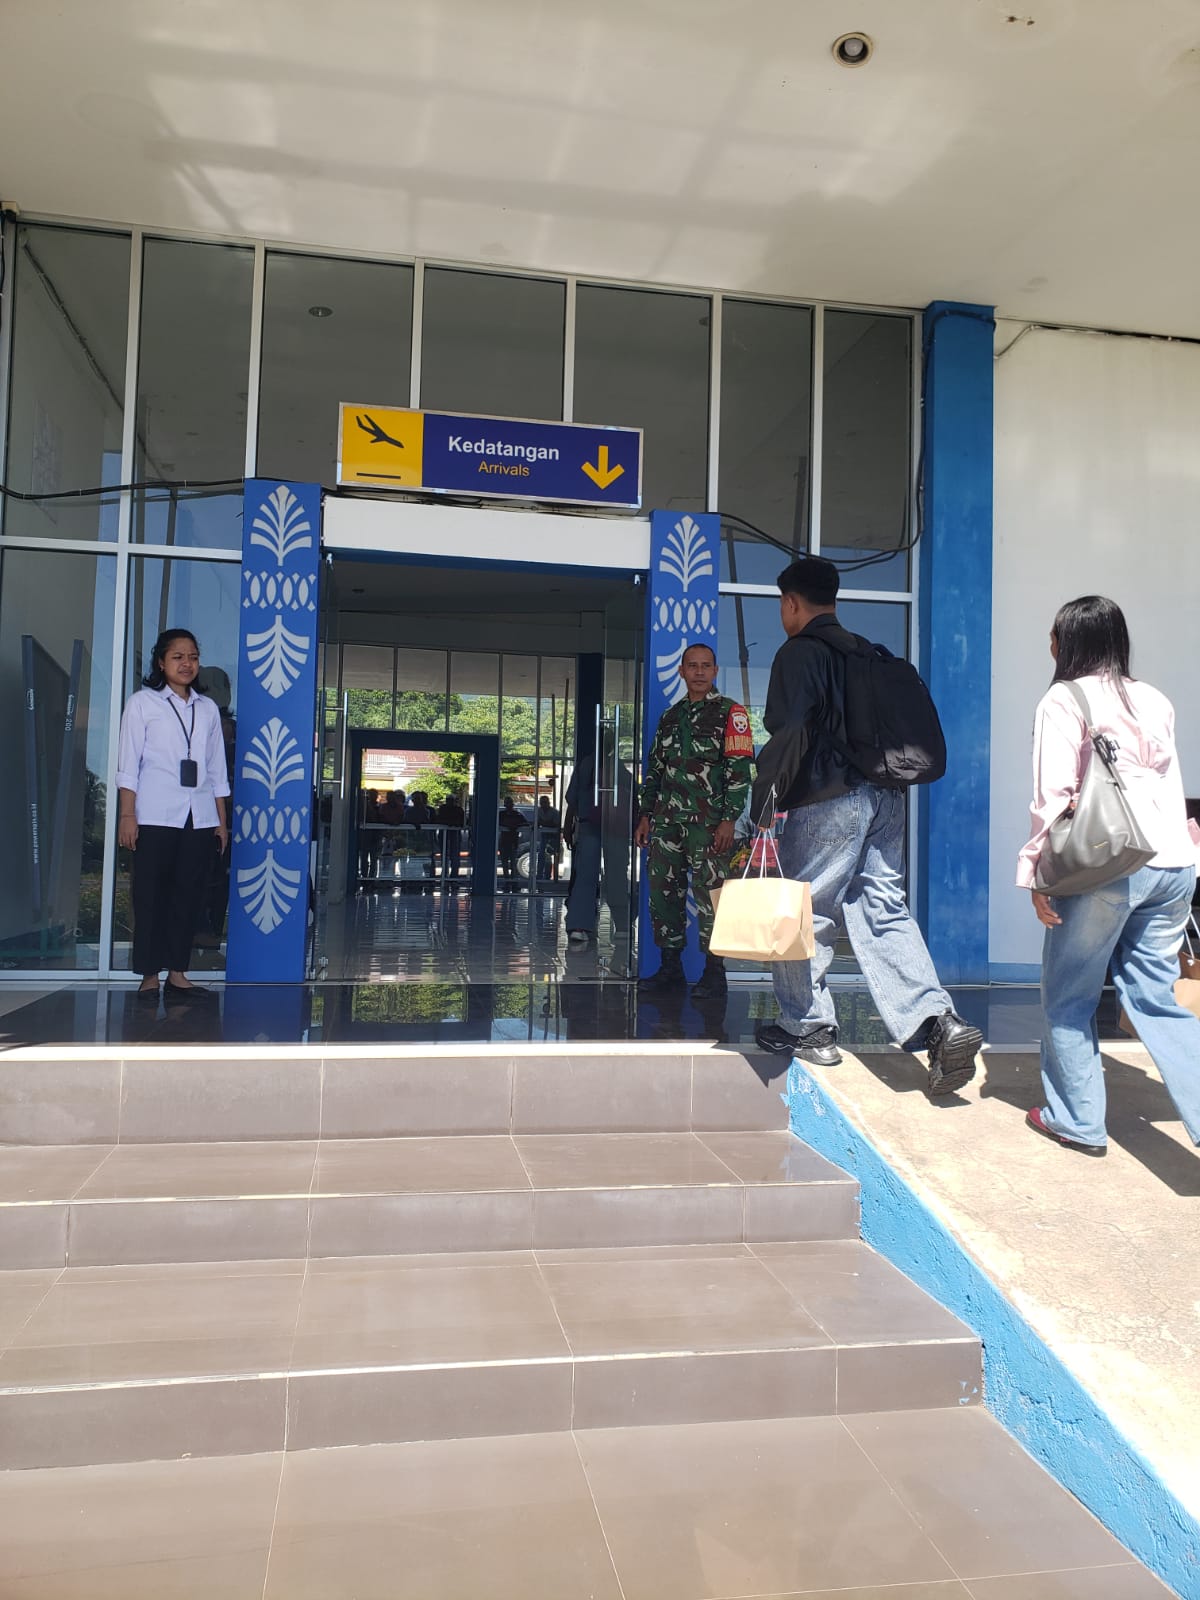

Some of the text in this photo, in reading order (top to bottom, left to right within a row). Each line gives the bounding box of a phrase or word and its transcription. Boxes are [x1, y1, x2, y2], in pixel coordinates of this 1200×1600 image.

[448, 436, 559, 462] Kedatangan
[479, 461, 530, 477] Arrivals
[65, 718, 73, 732] 200
